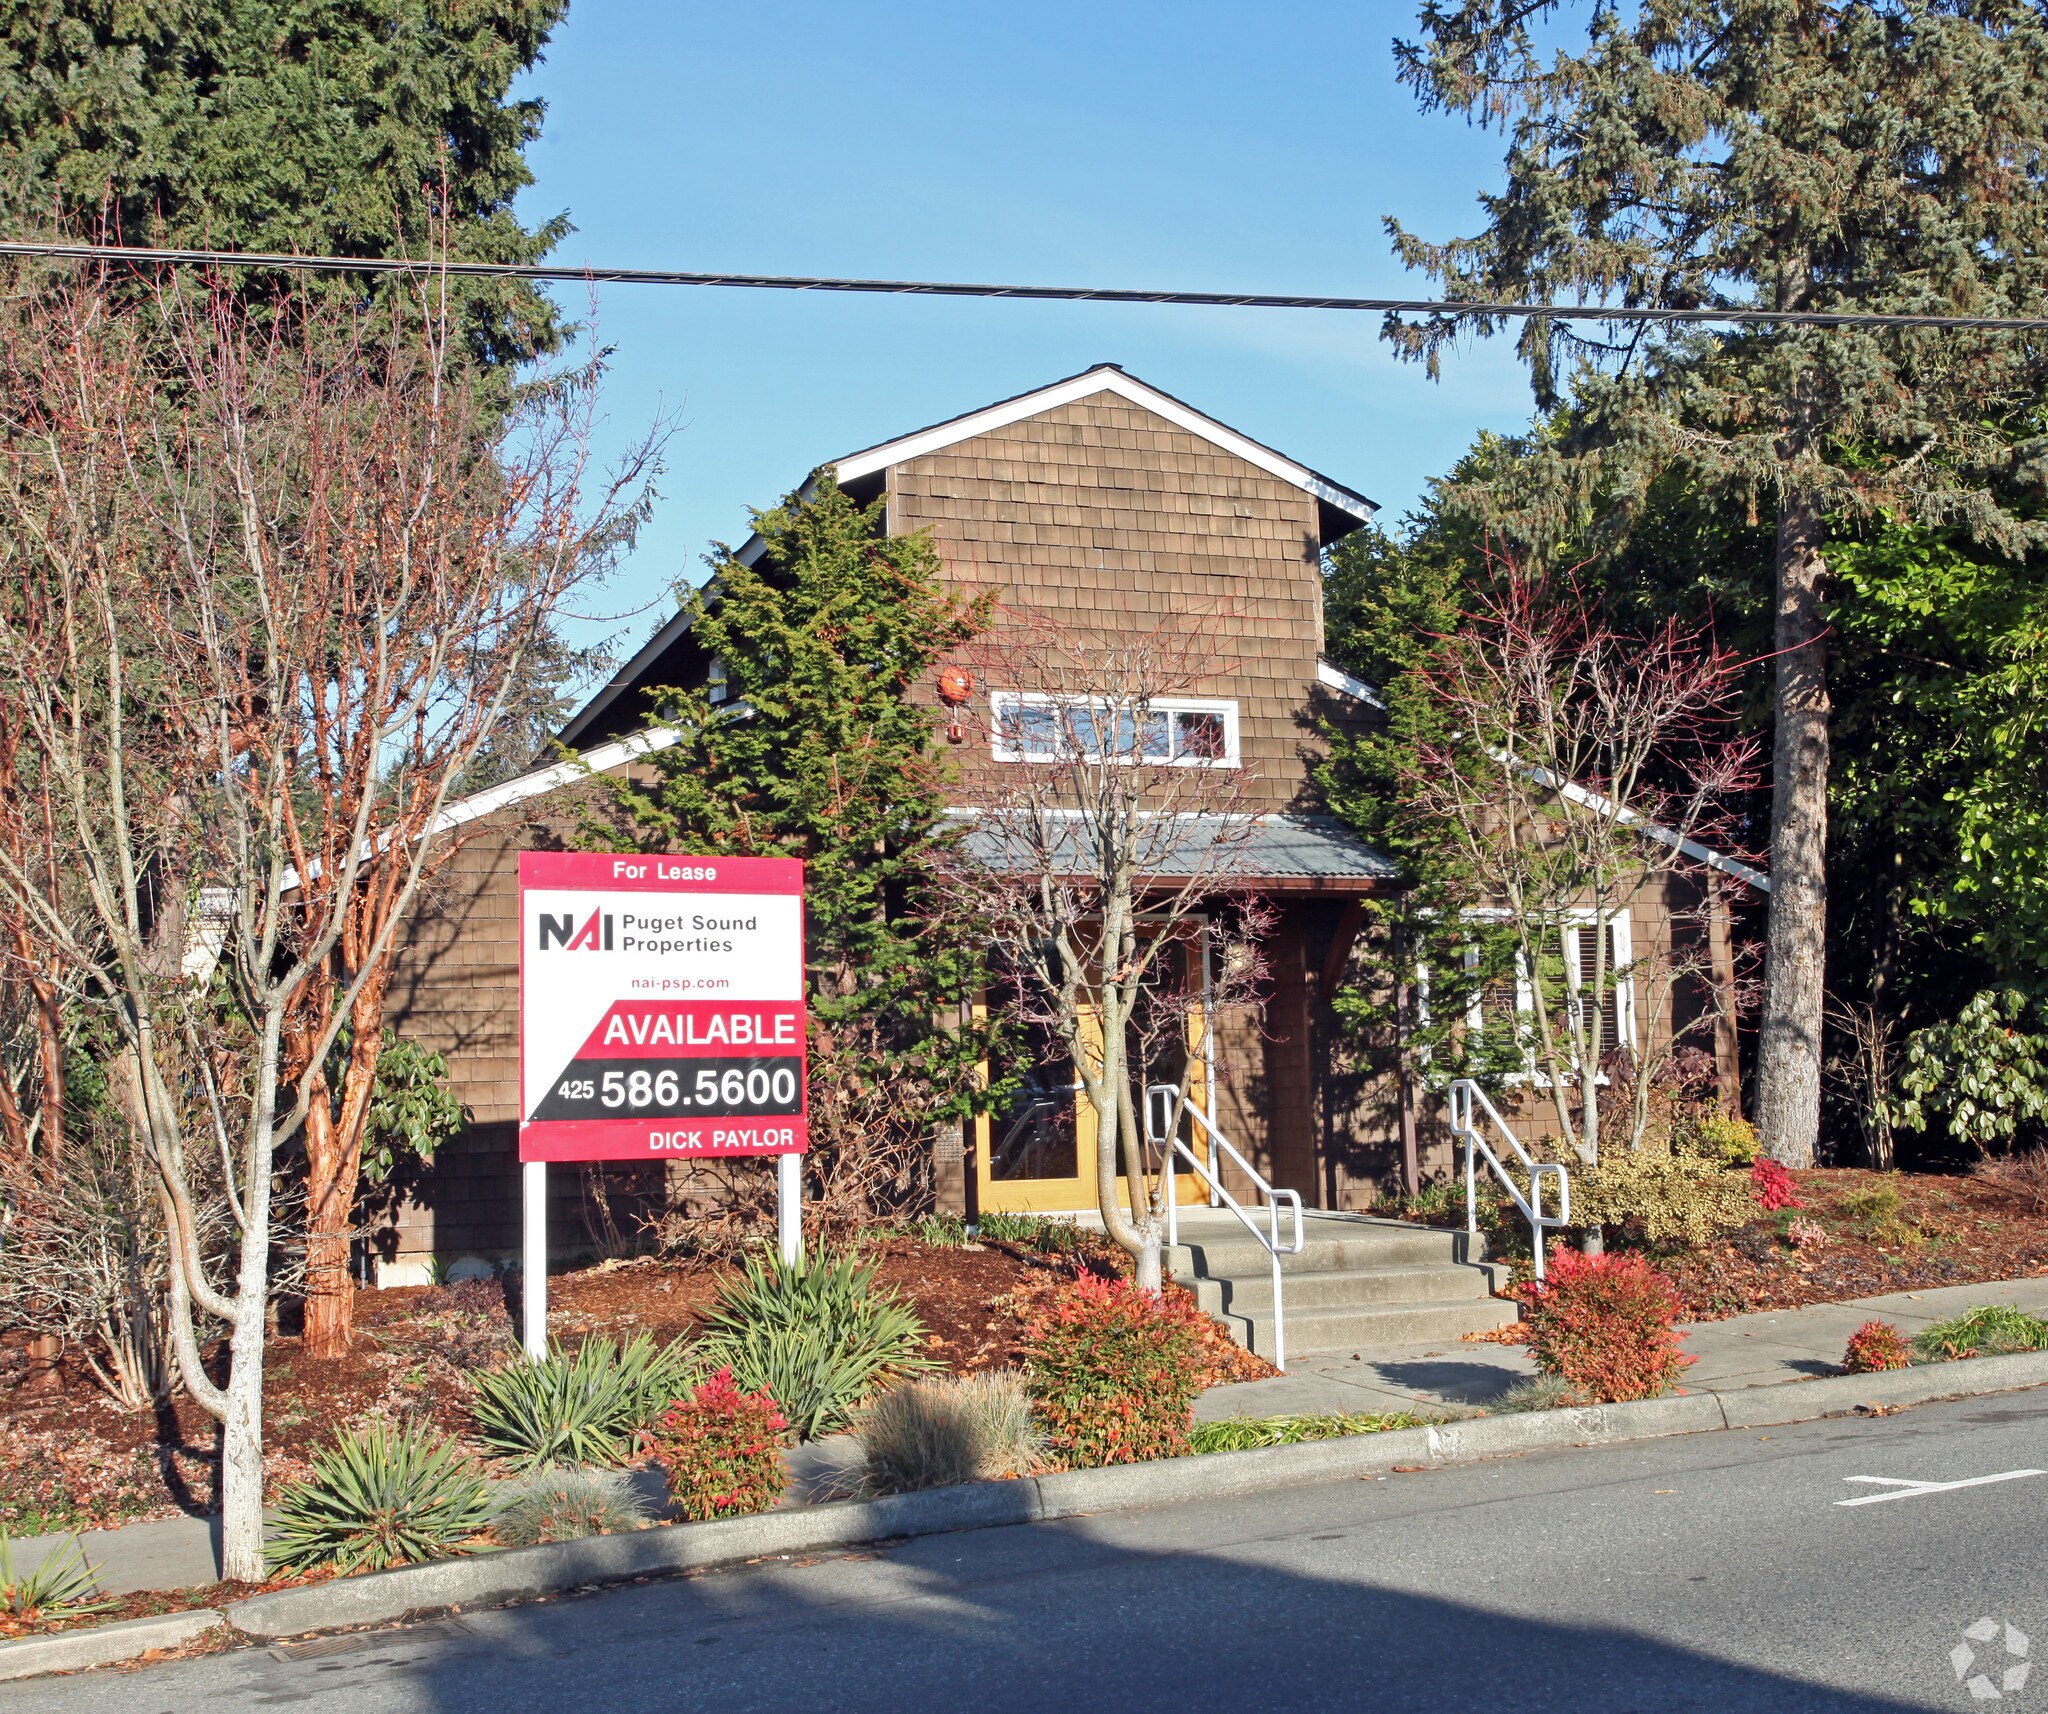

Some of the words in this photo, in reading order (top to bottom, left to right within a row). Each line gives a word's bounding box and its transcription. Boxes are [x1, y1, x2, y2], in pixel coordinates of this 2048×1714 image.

[614, 862, 646, 879] For
[658, 863, 717, 880] Lease
[539, 905, 613, 951] NAI
[623, 914, 683, 933] Puget
[693, 916, 757, 930] Sound
[623, 937, 732, 954] Properties
[631, 977, 729, 990] nai-psp.com
[603, 1014, 795, 1045] AVAILABLE
[558, 1081, 594, 1099] 425
[601, 1068, 795, 1107] 586.5600
[649, 1132, 702, 1150] DICK
[713, 1129, 793, 1148] PAYLOR
